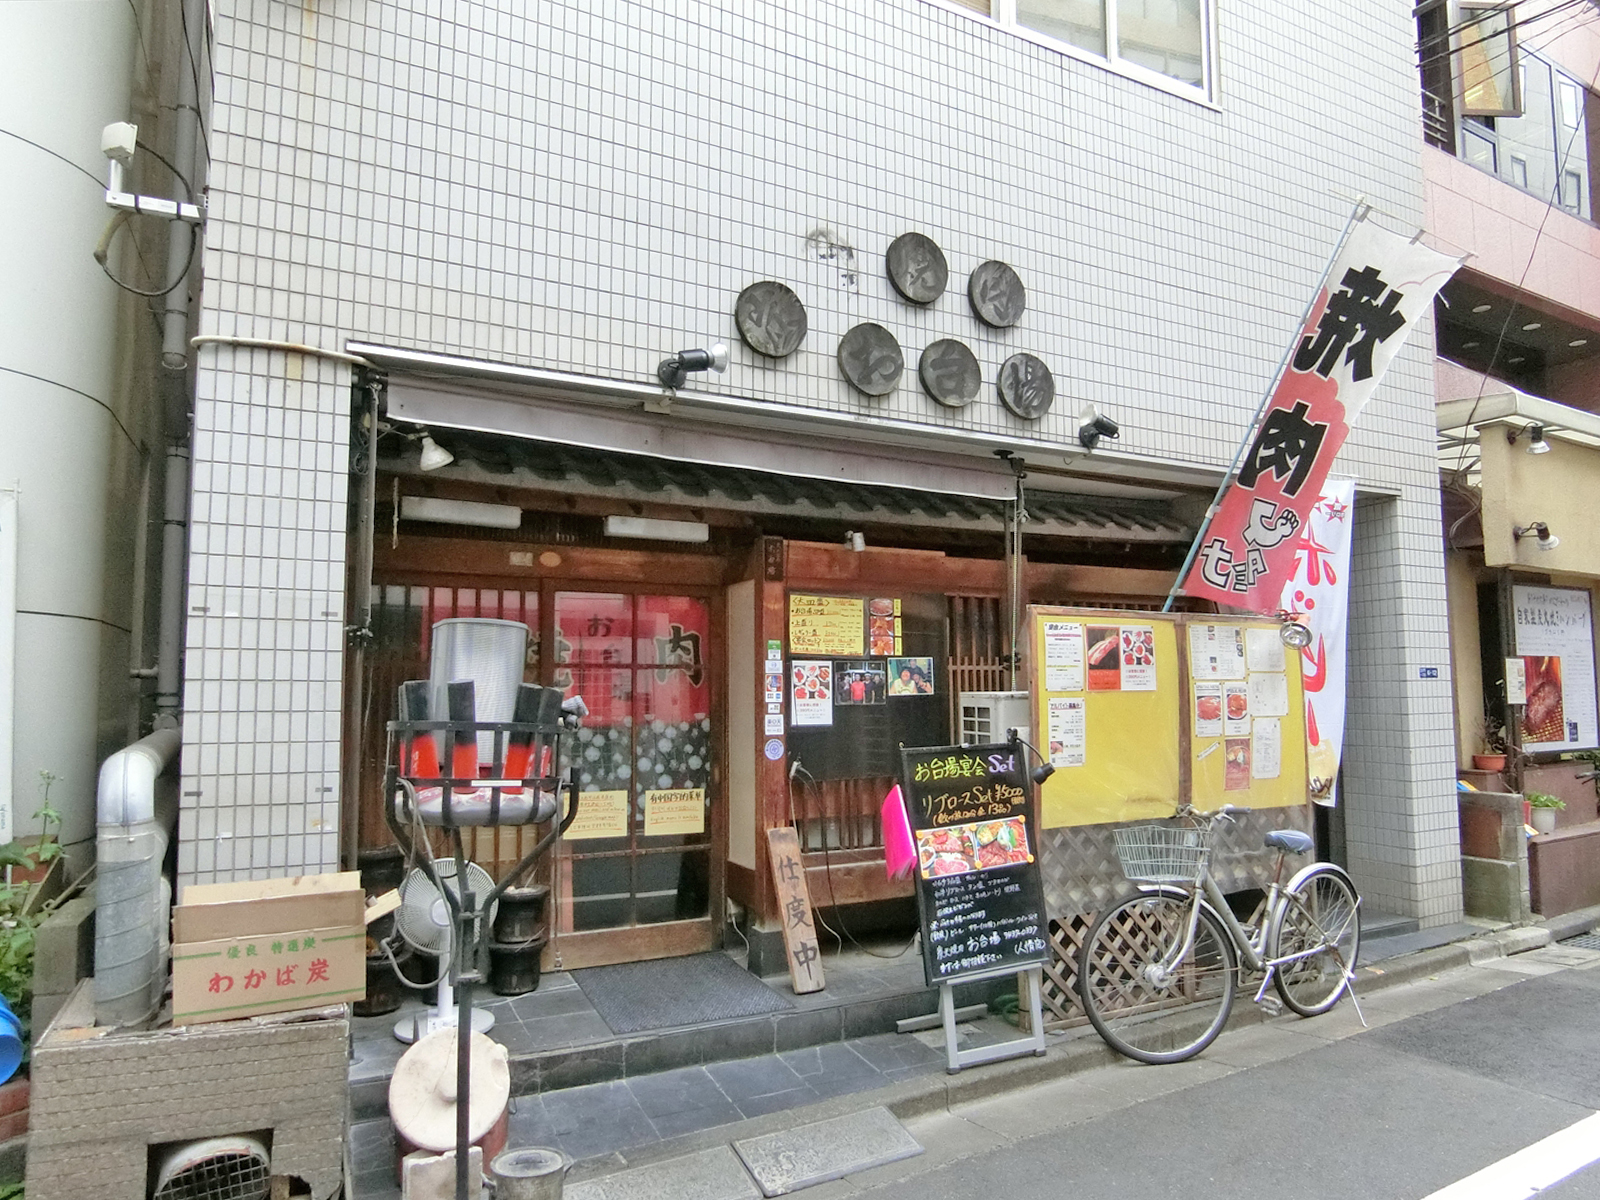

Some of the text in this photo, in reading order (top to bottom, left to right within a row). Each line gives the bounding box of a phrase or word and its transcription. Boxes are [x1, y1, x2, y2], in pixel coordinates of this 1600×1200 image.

[914, 753, 1016, 783] お台場宴会 Set
[777, 854, 818, 981] 仕度中
[227, 943, 259, 960] 優良
[208, 957, 331, 995] わかば炭
